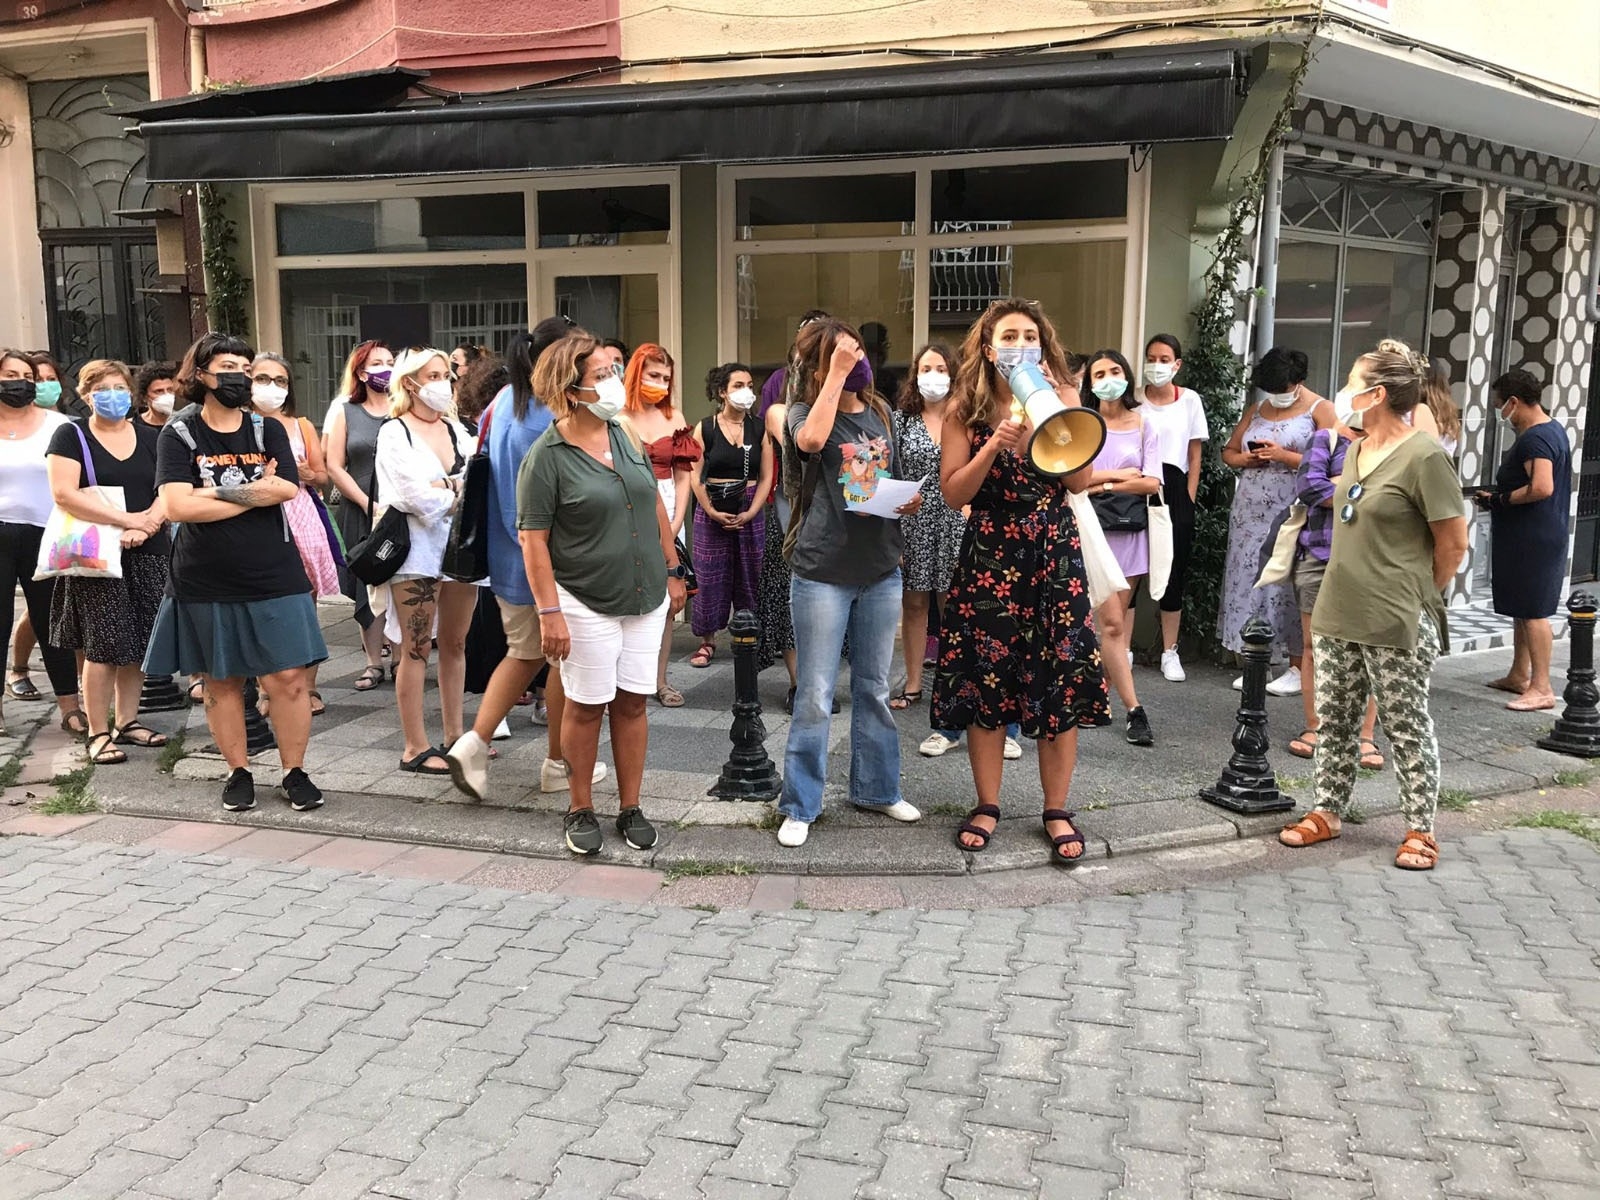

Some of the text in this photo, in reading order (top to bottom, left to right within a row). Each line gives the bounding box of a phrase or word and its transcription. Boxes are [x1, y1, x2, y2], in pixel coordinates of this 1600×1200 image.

[23, 5, 38, 19] 39
[239, 453, 267, 465] TUN
[849, 494, 860, 503] GOT
